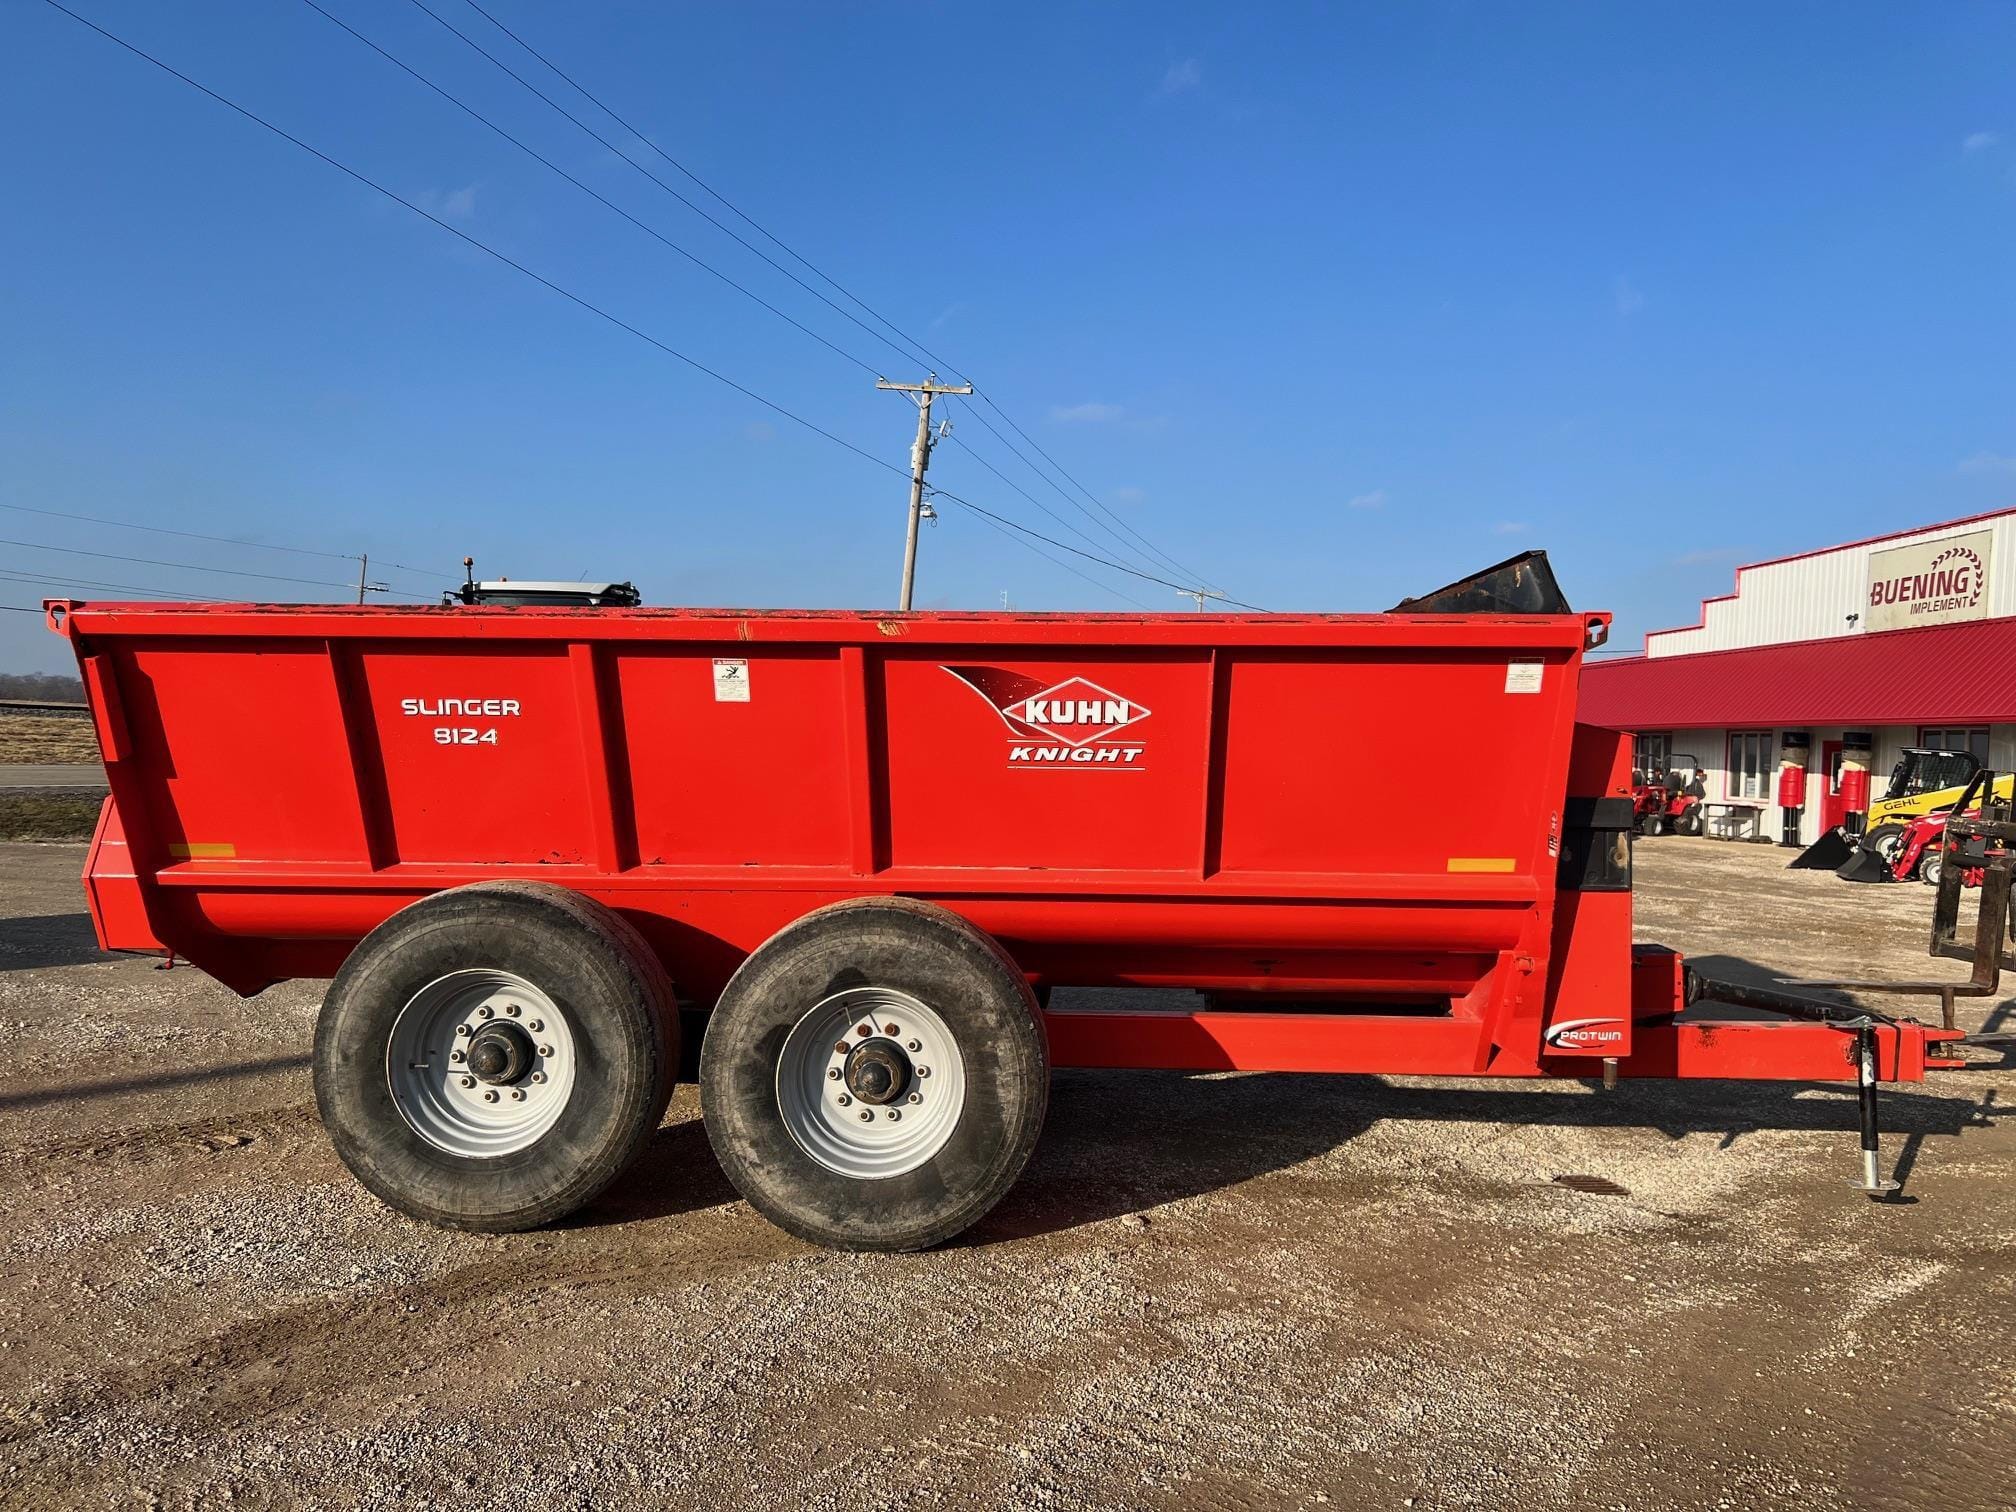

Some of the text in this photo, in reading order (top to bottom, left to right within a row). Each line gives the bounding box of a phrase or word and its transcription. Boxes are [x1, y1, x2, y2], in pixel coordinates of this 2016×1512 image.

[1870, 567, 1970, 606] BUENING
[1910, 596, 1969, 615] IMPLEMENT
[401, 699, 521, 716] SLINGER
[1025, 700, 1130, 724] KUHN
[434, 728, 498, 745] 8124
[1009, 747, 1143, 763] KNIGHT
[1884, 798, 1921, 811] GEHL
[1560, 1031, 1622, 1041] PROTWIN
